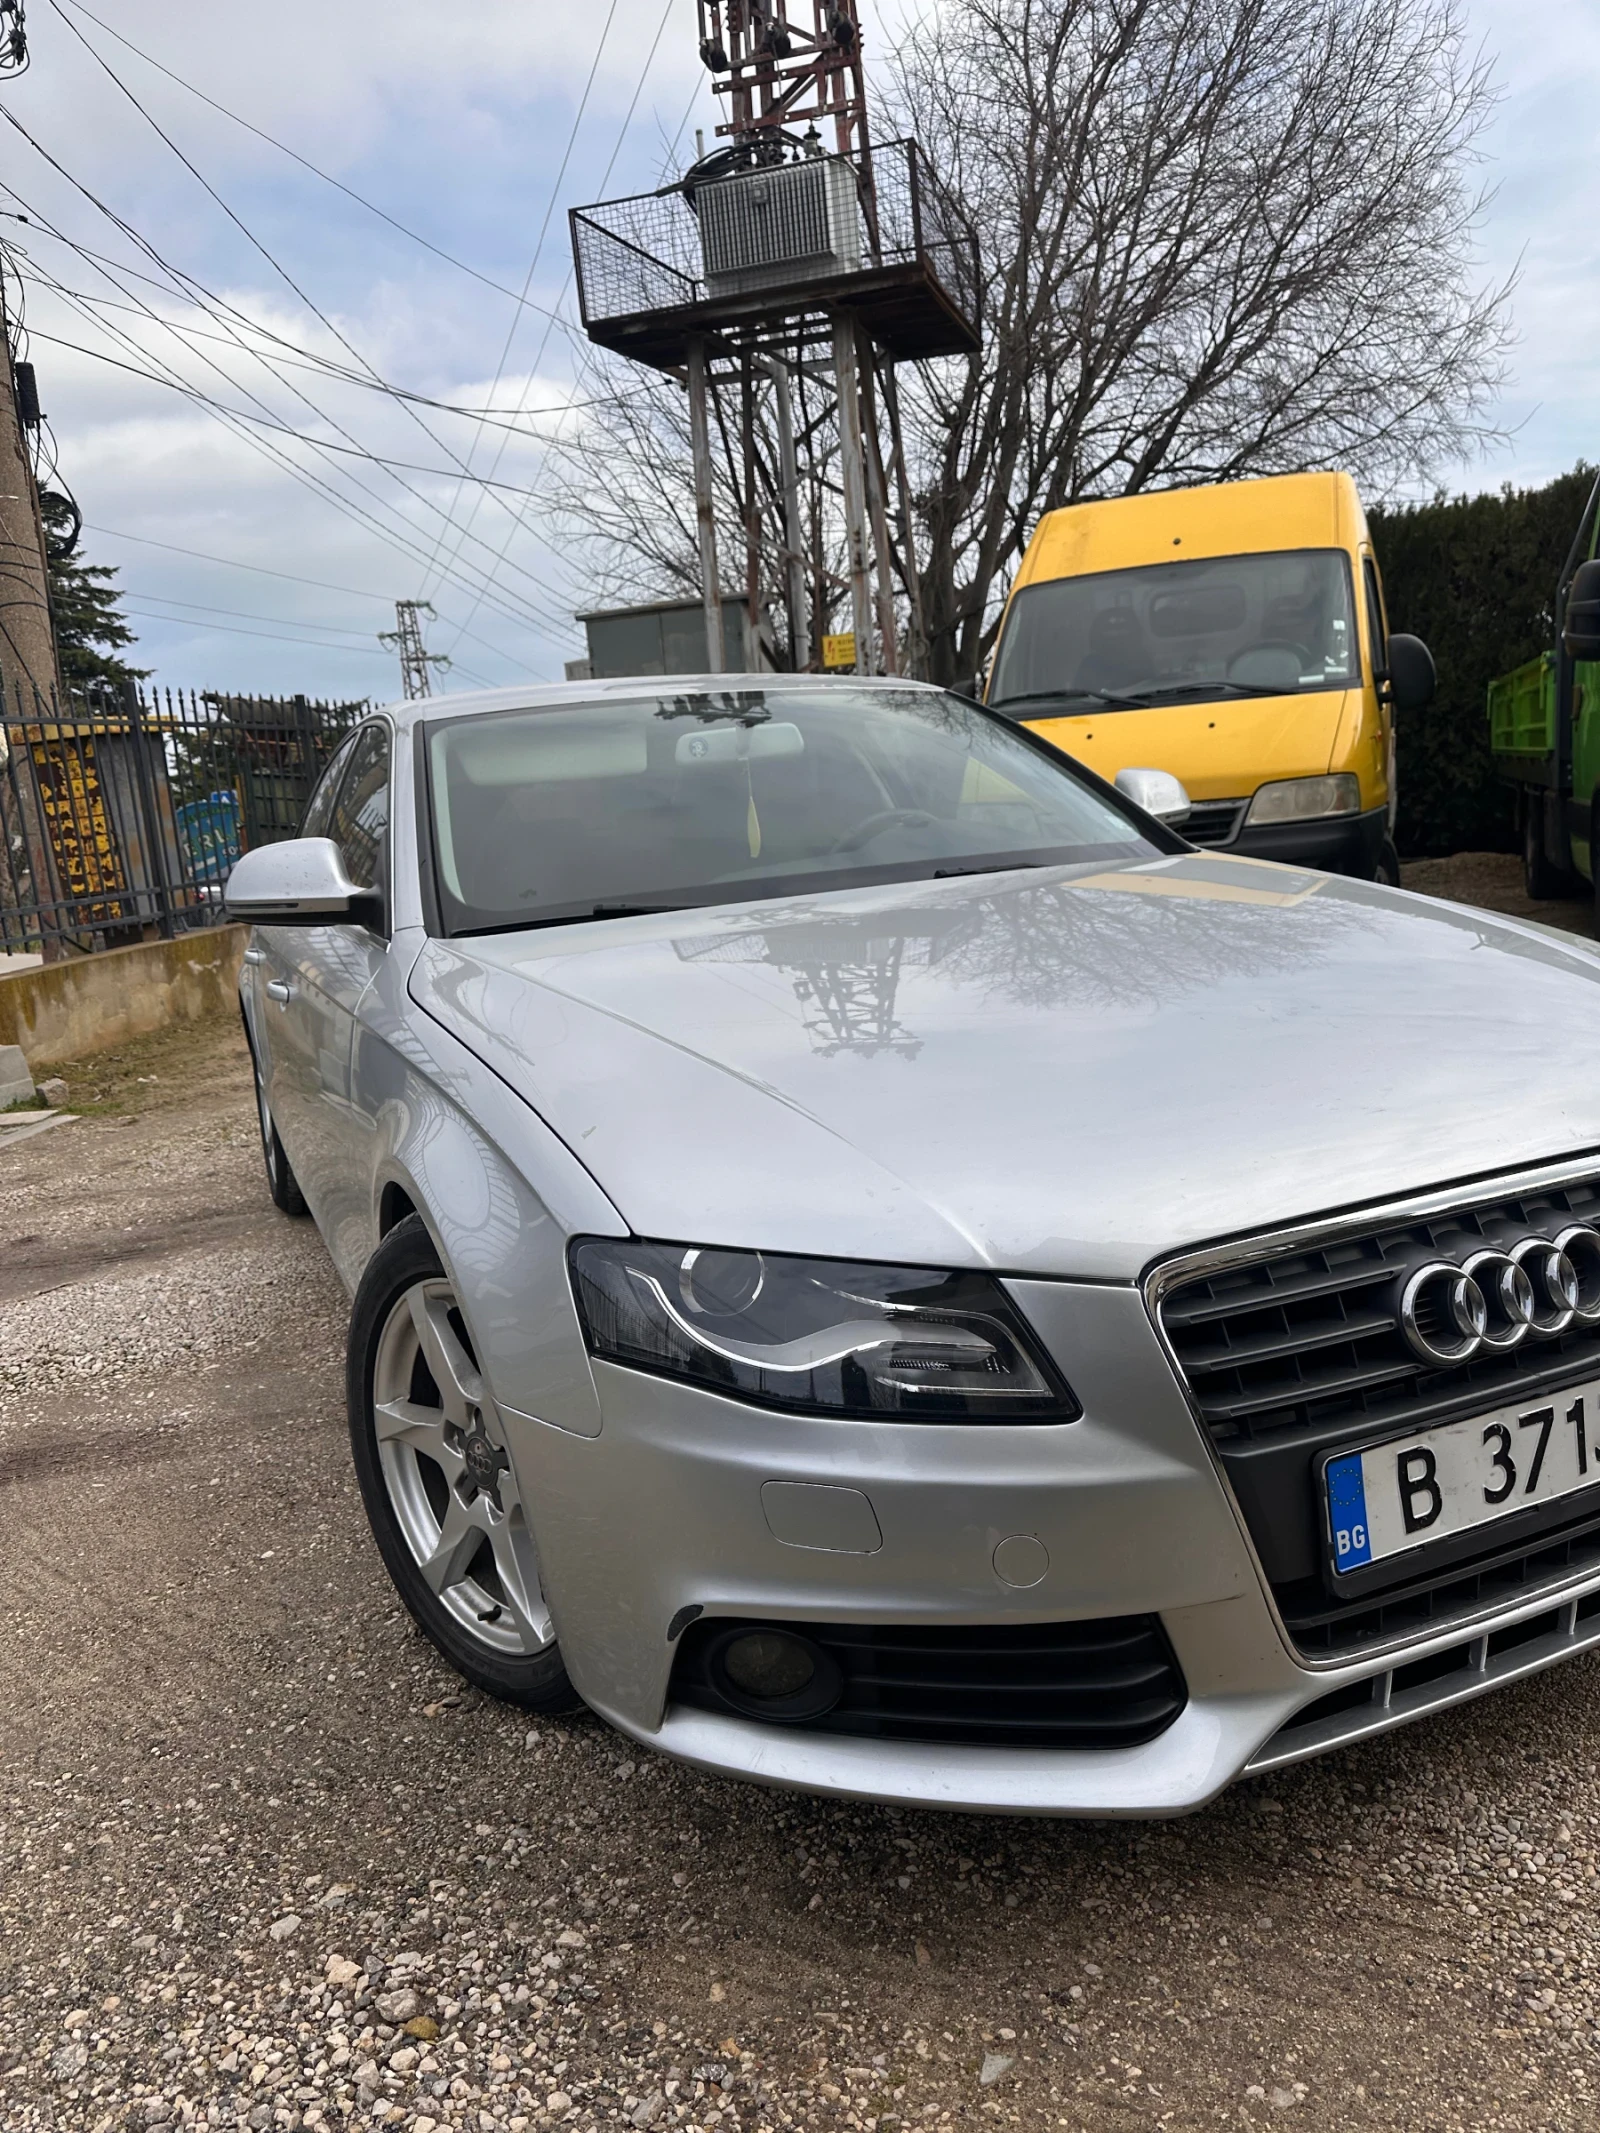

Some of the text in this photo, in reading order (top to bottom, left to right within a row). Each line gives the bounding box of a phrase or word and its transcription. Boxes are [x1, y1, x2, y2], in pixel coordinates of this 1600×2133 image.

[1397, 1394, 1600, 1534] B 371
[1336, 1524, 1367, 1556] BG
